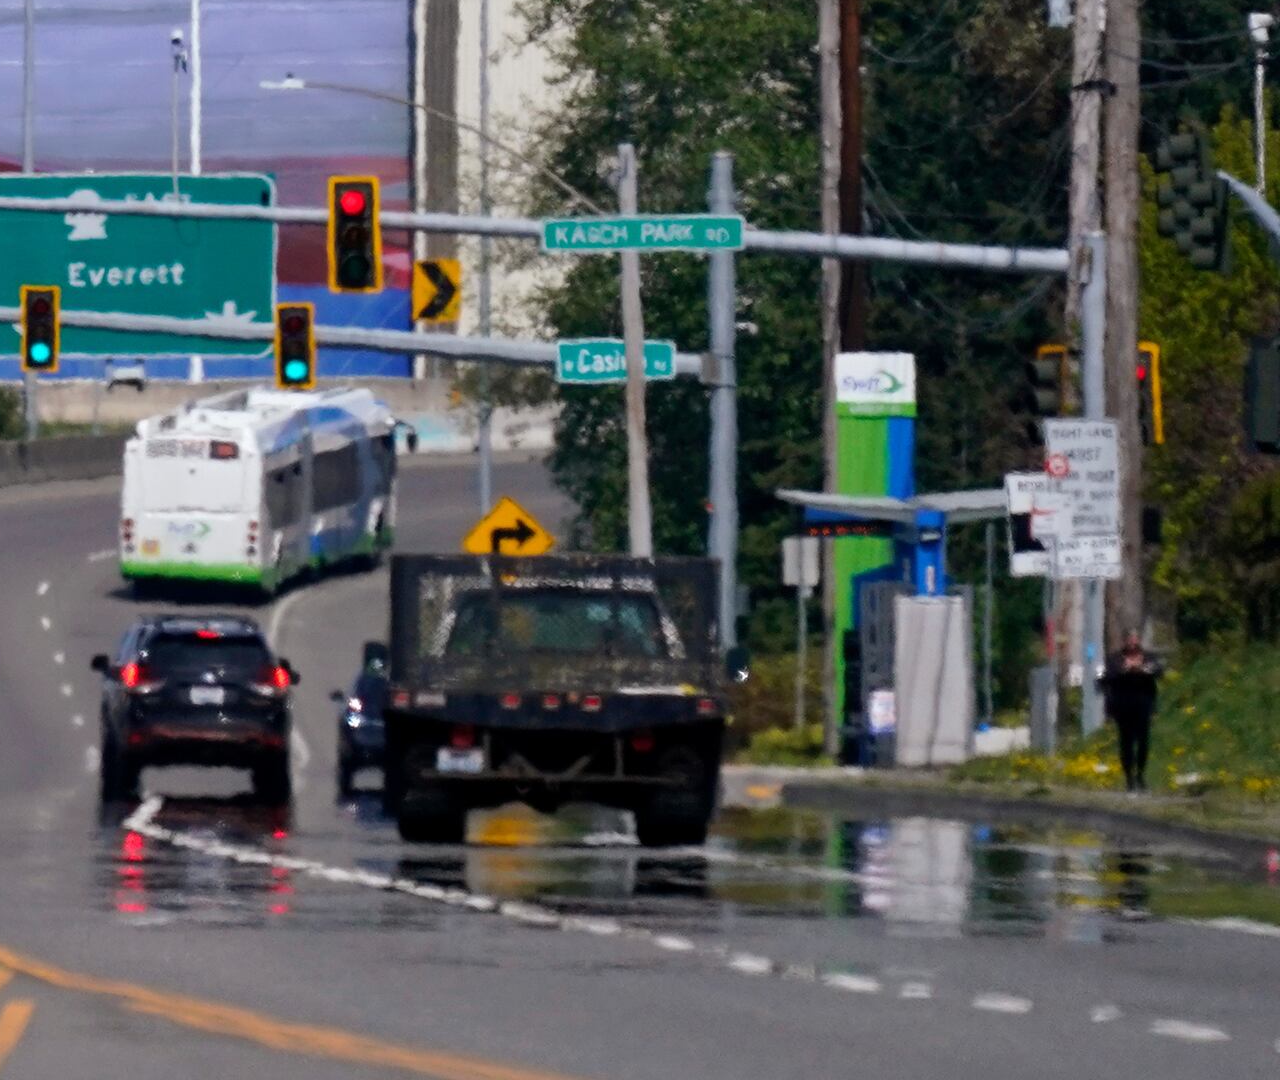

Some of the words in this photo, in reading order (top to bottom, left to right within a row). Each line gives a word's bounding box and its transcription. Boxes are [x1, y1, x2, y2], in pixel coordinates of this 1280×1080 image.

[641, 223, 694, 243] PARK
[67, 261, 185, 288] Everett
[577, 349, 646, 374] Casi
